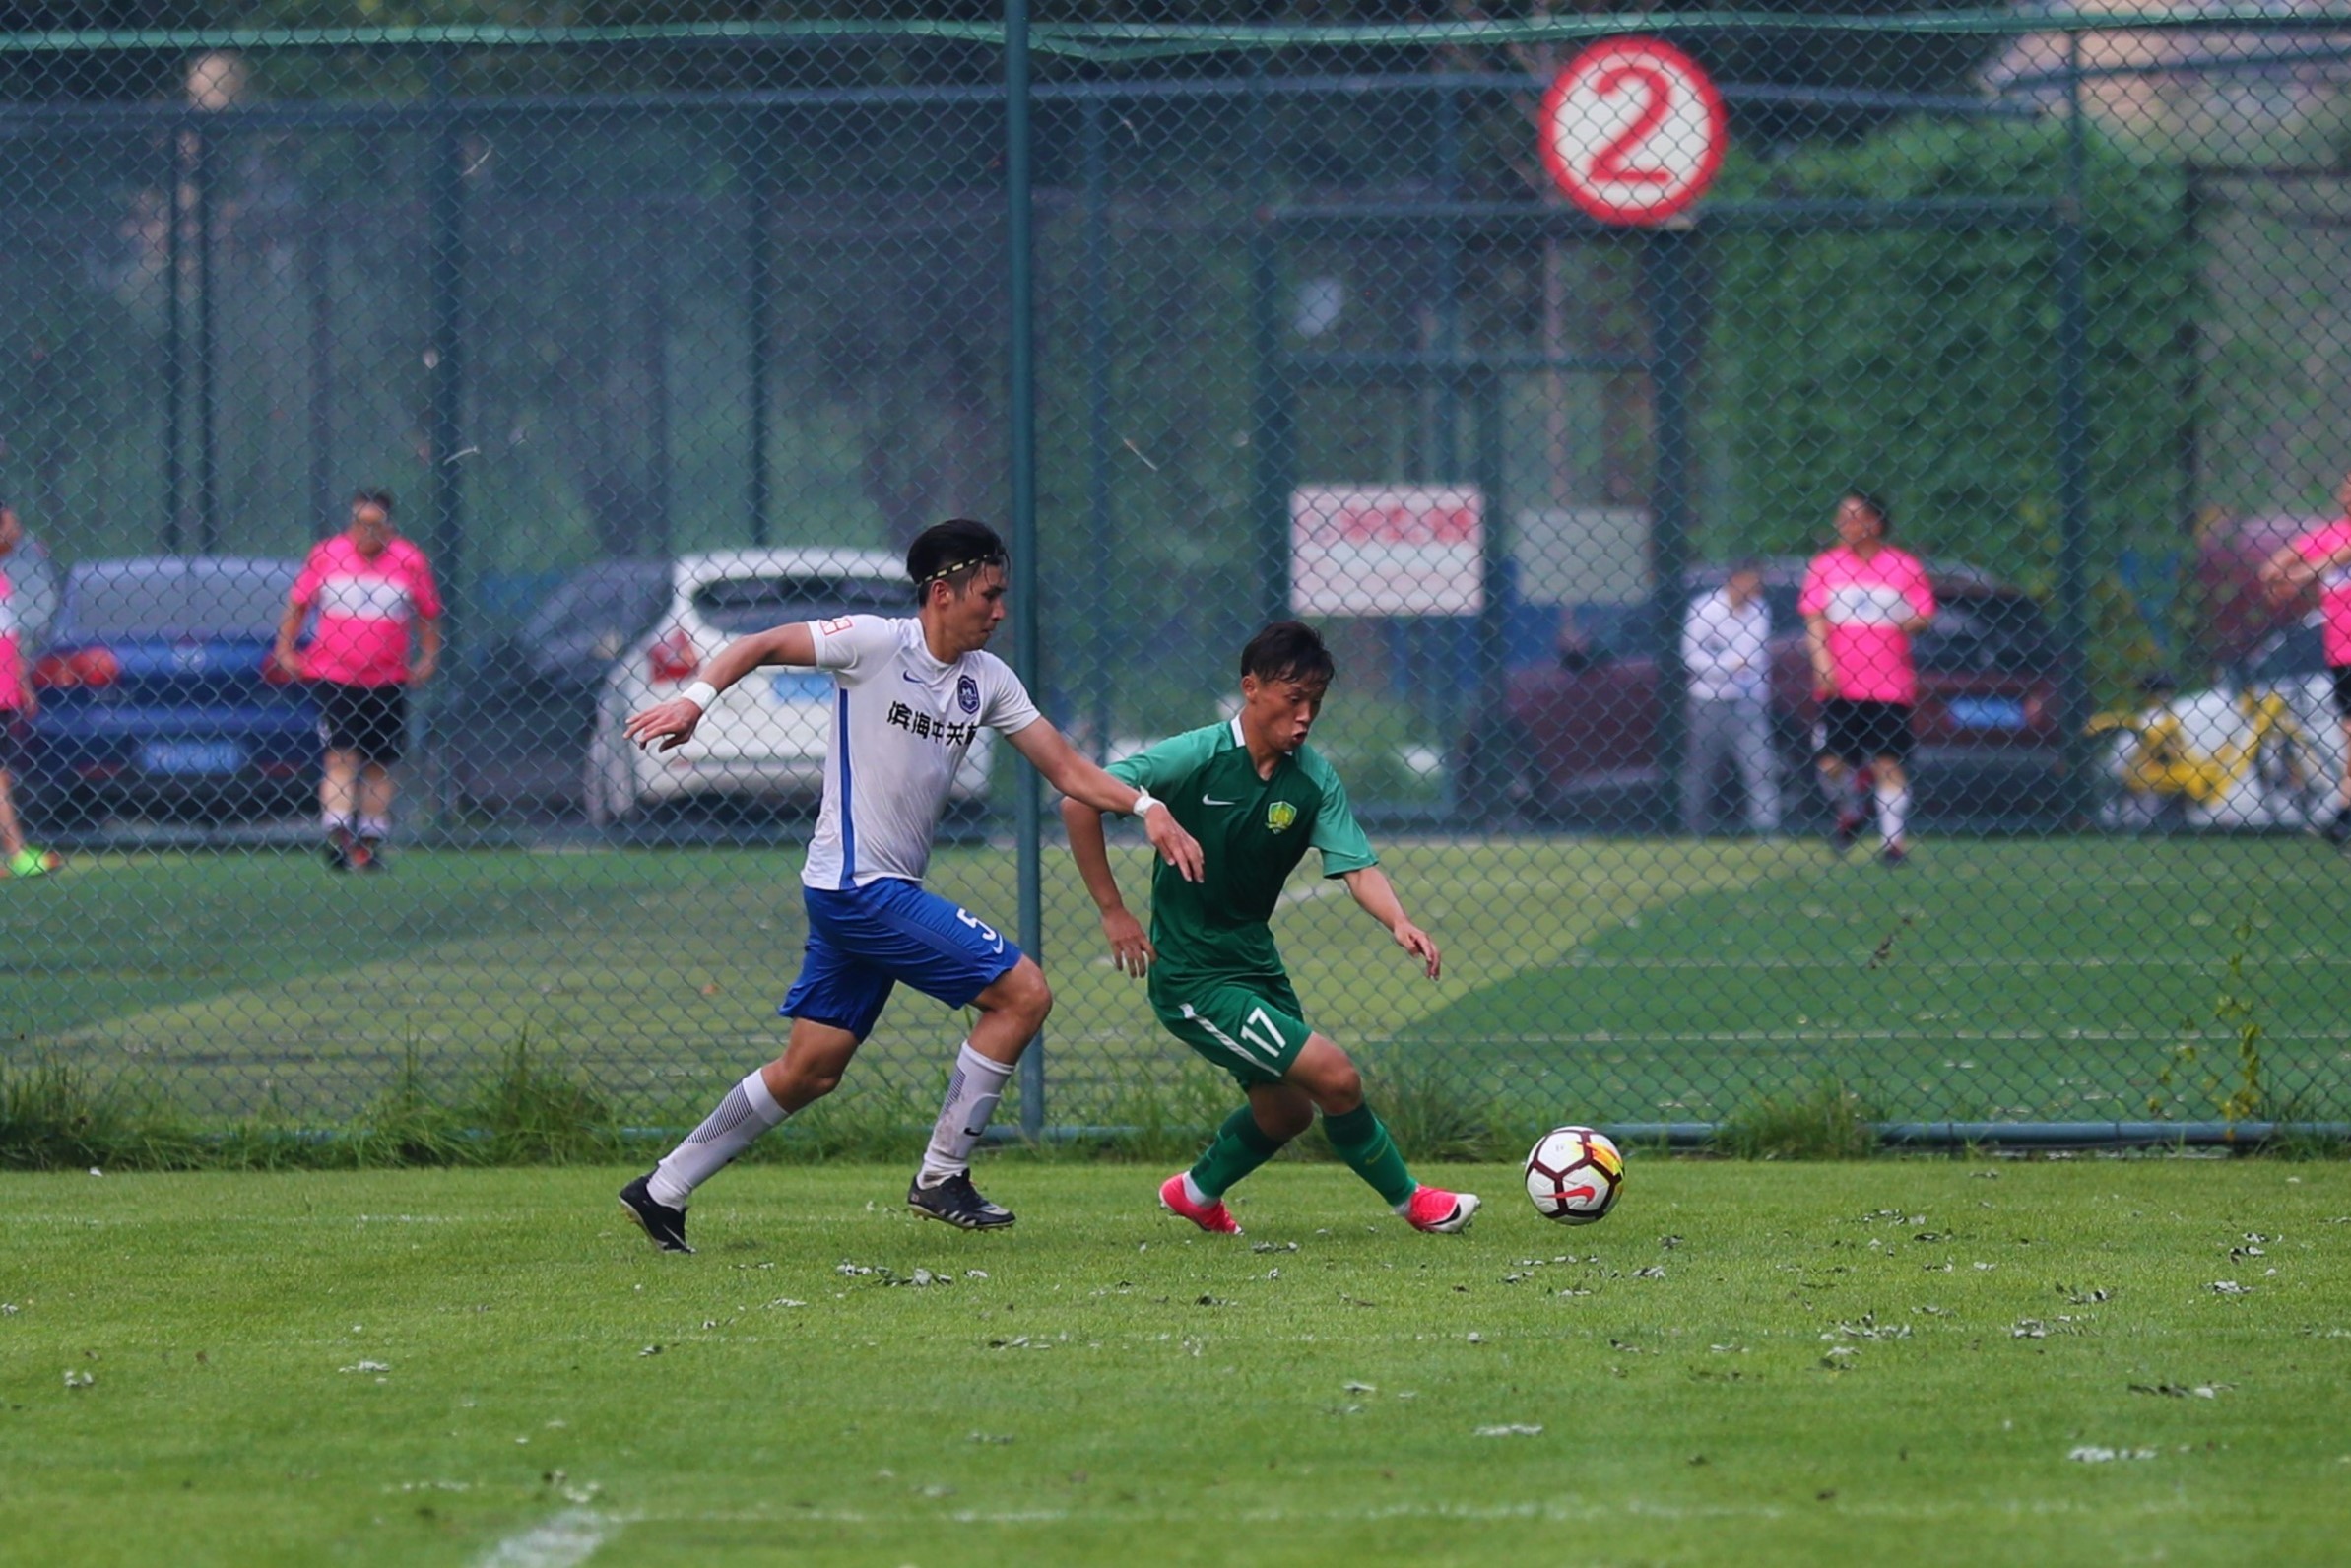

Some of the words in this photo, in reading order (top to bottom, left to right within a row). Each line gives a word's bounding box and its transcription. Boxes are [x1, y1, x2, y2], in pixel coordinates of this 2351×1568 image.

[1590, 66, 1670, 184] 2
[955, 907, 998, 942] 5
[1240, 1006, 1287, 1059] 17
